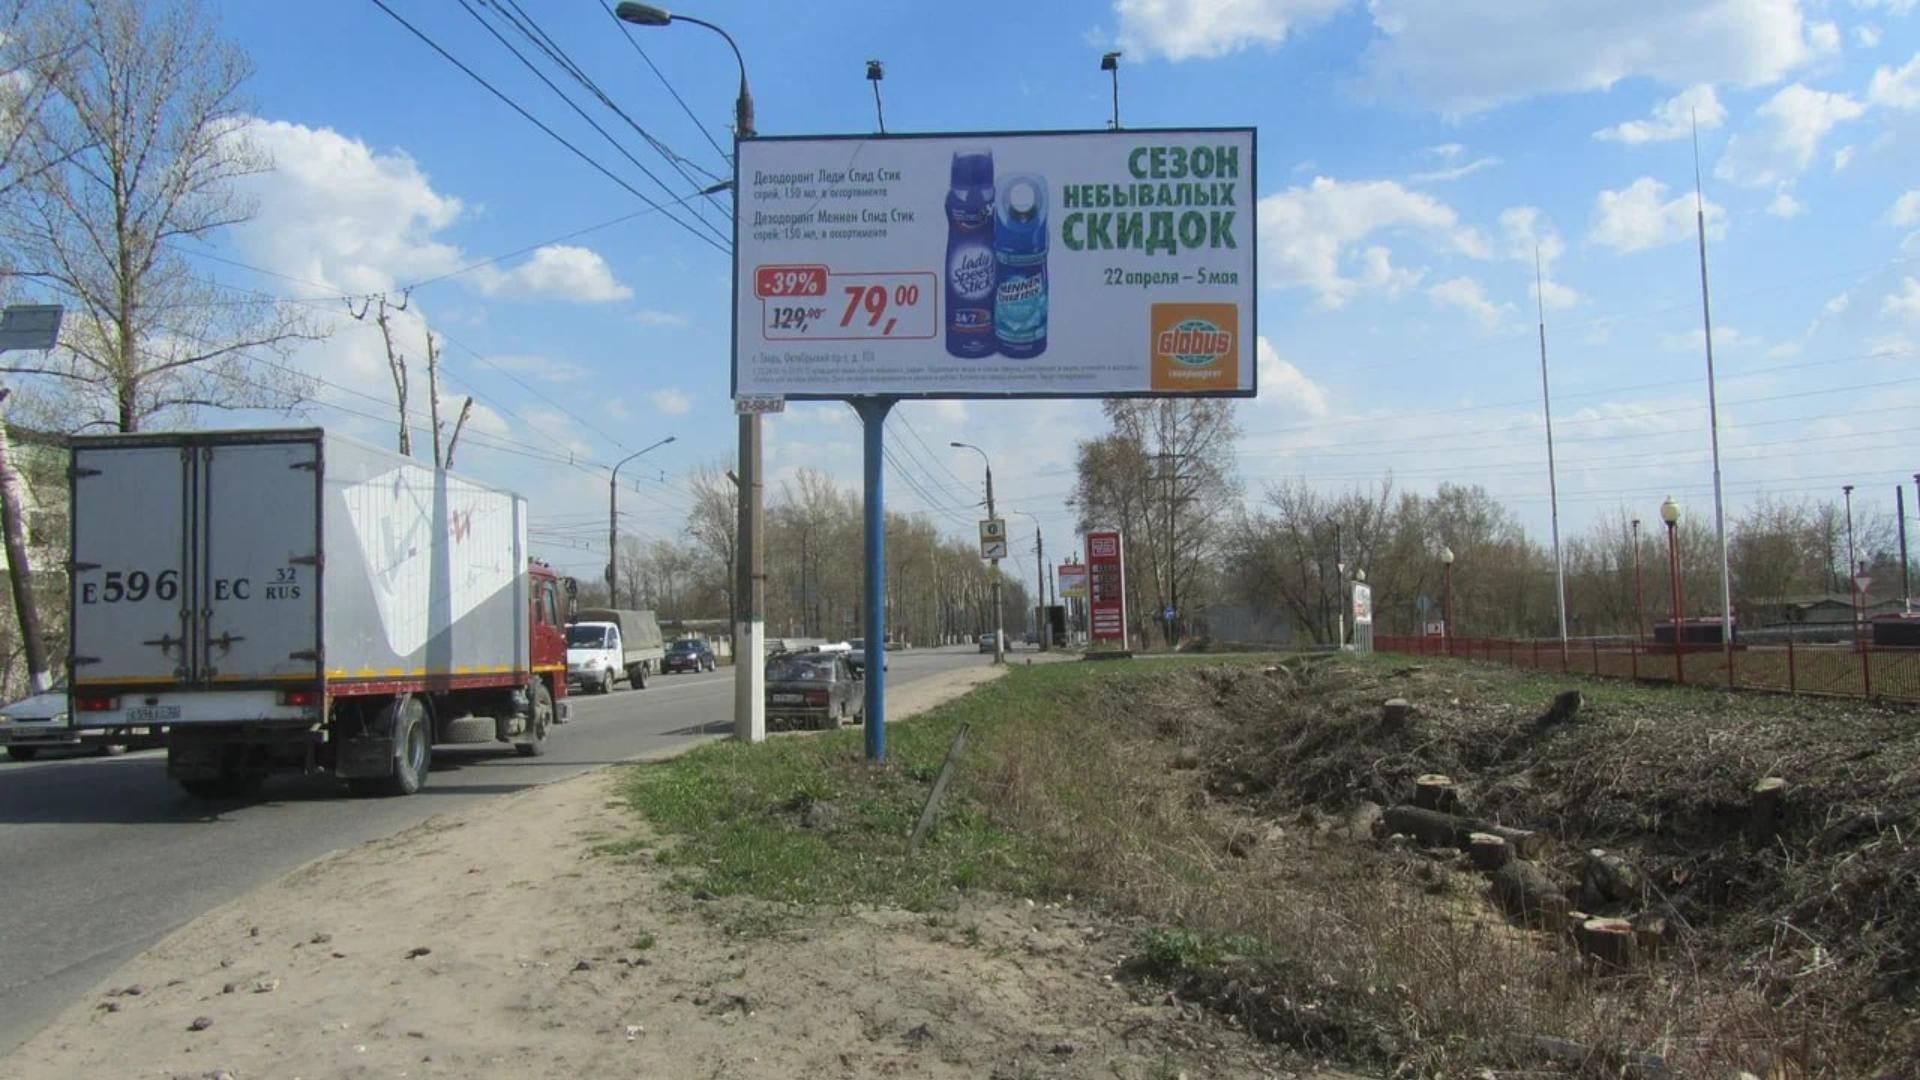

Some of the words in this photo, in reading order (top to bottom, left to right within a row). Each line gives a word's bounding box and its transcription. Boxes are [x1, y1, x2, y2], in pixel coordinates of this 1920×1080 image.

[1128, 146, 1239, 179] СЕЗОН
[753, 171, 814, 185] Дезодорант
[818, 169, 845, 184] Леди
[848, 168, 875, 183] Спид
[877, 167, 901, 181] Стик
[784, 187, 801, 199] 150
[830, 187, 887, 200] ассортименте
[1063, 183, 1236, 208] НЕБЫВАЛЫХ
[753, 211, 814, 226] Дезодорант
[817, 209, 858, 224] Меннен
[862, 208, 888, 223] Спид
[890, 207, 914, 222] Стик
[784, 228, 801, 240] 150
[830, 228, 887, 241] ассортименте
[1062, 210, 1238, 256] СКИДОК
[764, 271, 818, 295] -39%
[1104, 267, 1124, 286] 22
[1125, 270, 1179, 288] апреля
[1197, 266, 1206, 285] 5
[1208, 270, 1238, 285] мая
[276, 567, 297, 581] 32
[266, 586, 301, 600] RUS
